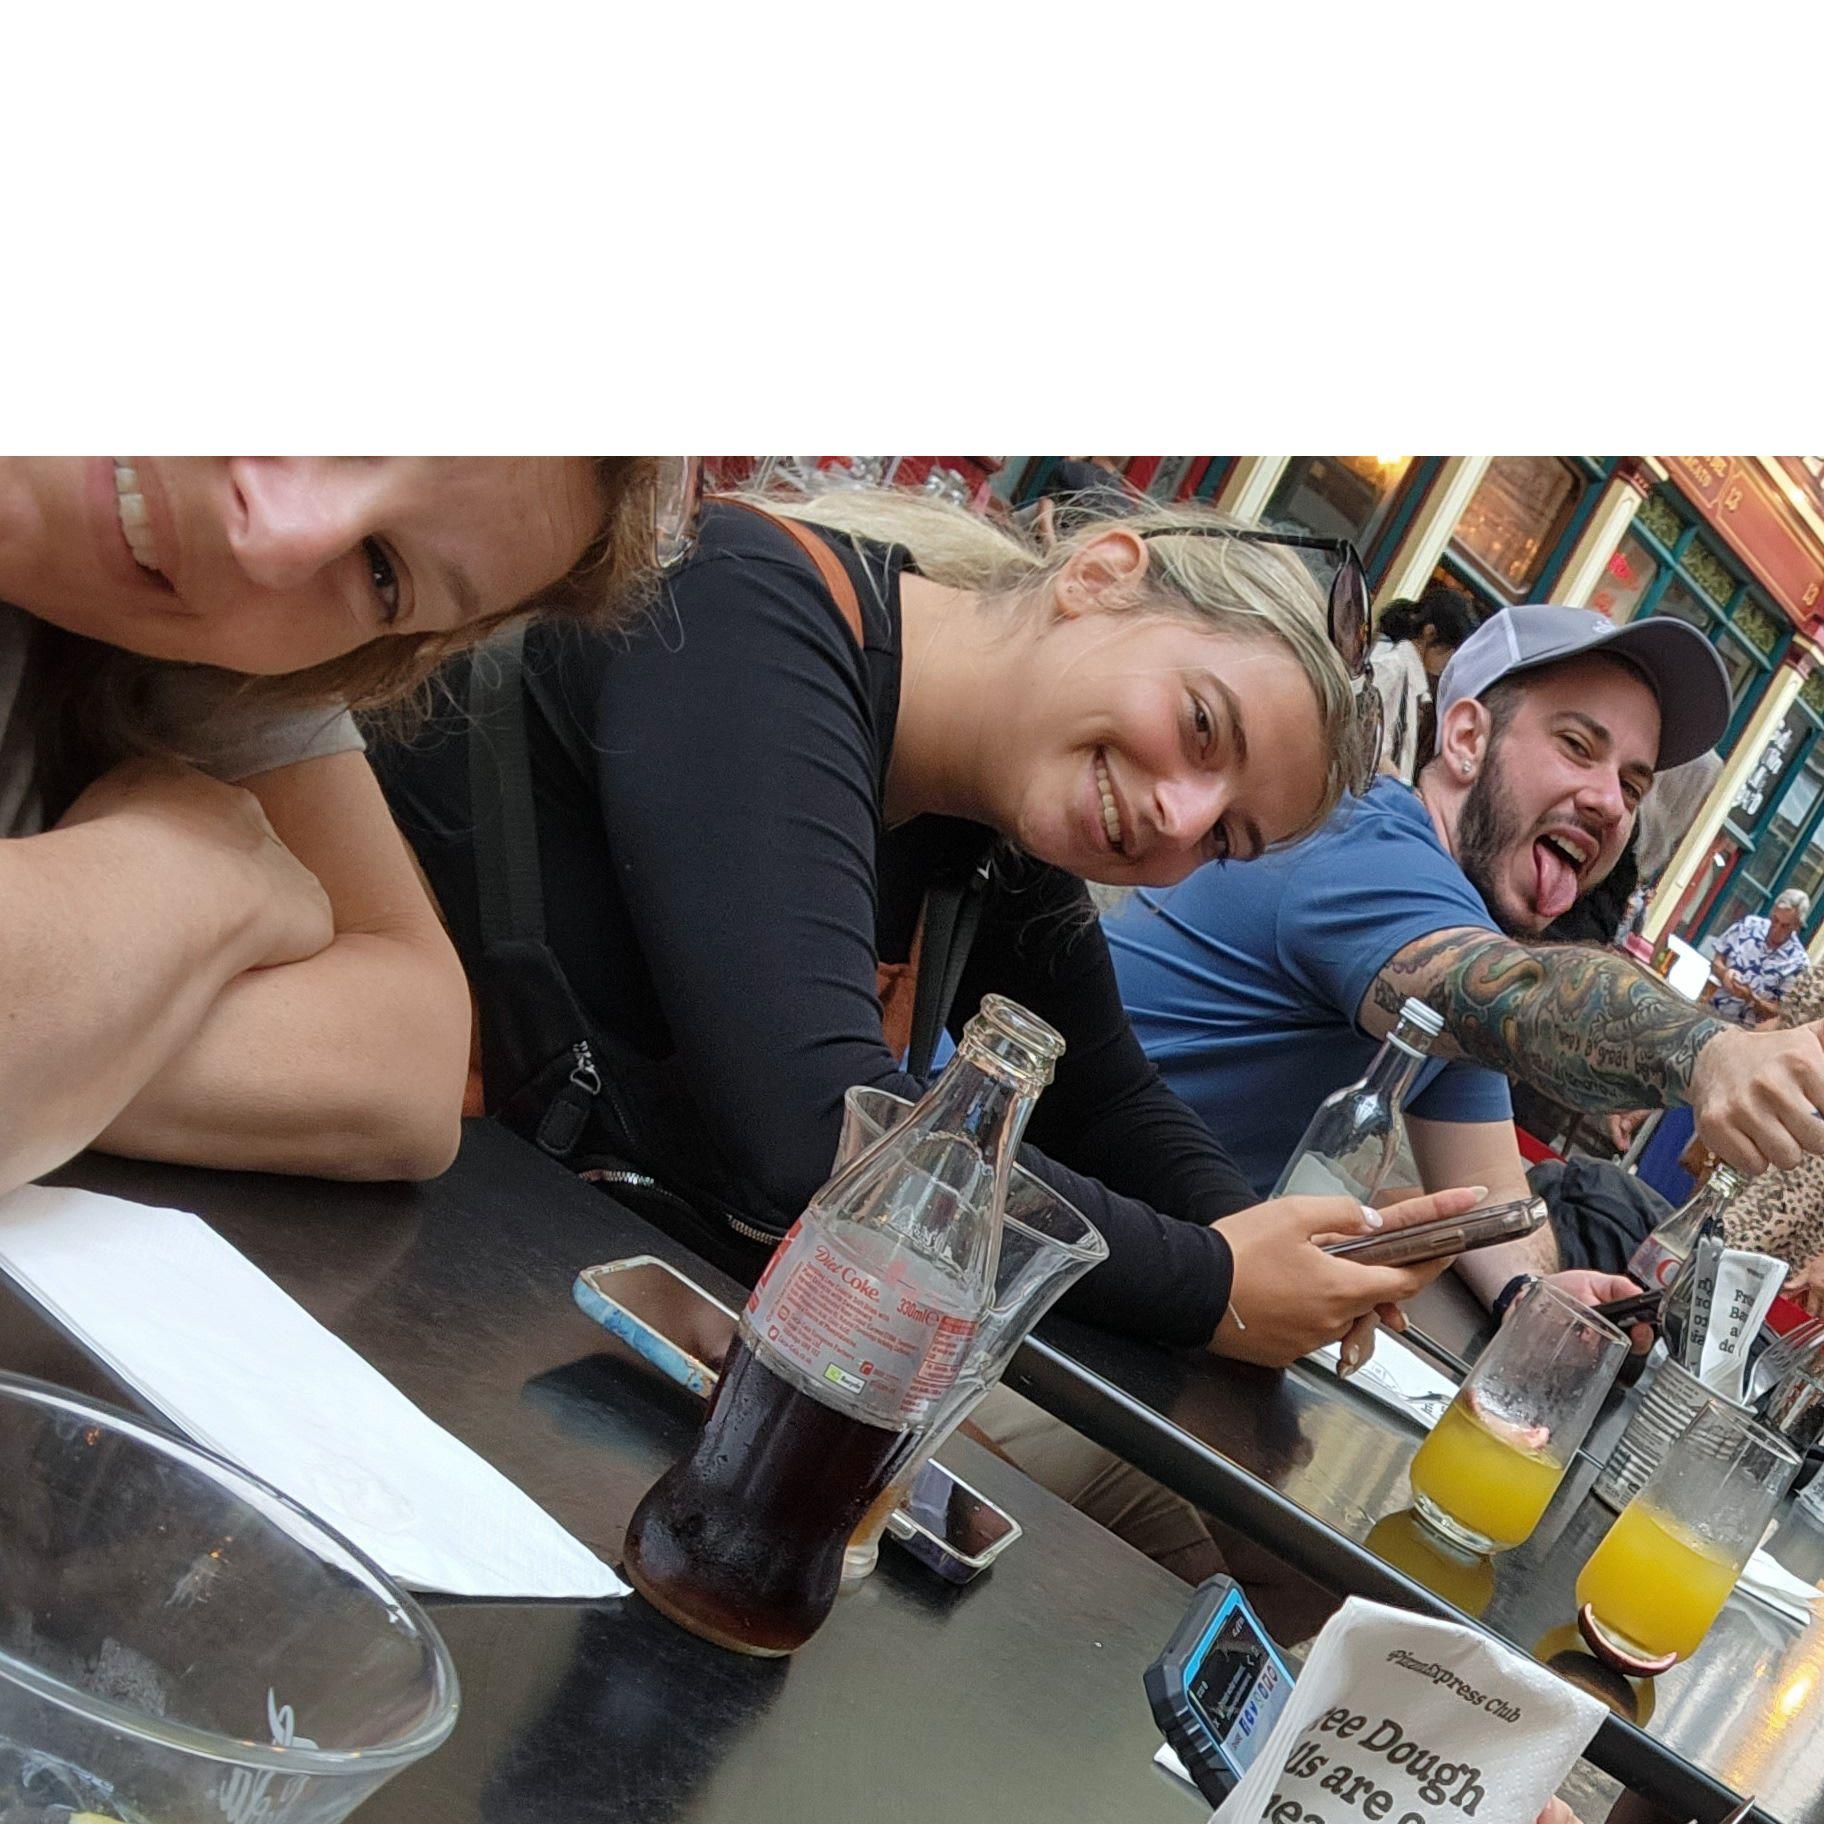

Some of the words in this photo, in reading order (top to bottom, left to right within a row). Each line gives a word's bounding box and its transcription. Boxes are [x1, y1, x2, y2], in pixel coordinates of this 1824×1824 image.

[814, 1245, 841, 1272] Diet
[1484, 1699, 1521, 1724] Club
[1308, 1706, 1368, 1739] ee
[1357, 1718, 1485, 1818] Dough
[1319, 1766, 1394, 1821] are
